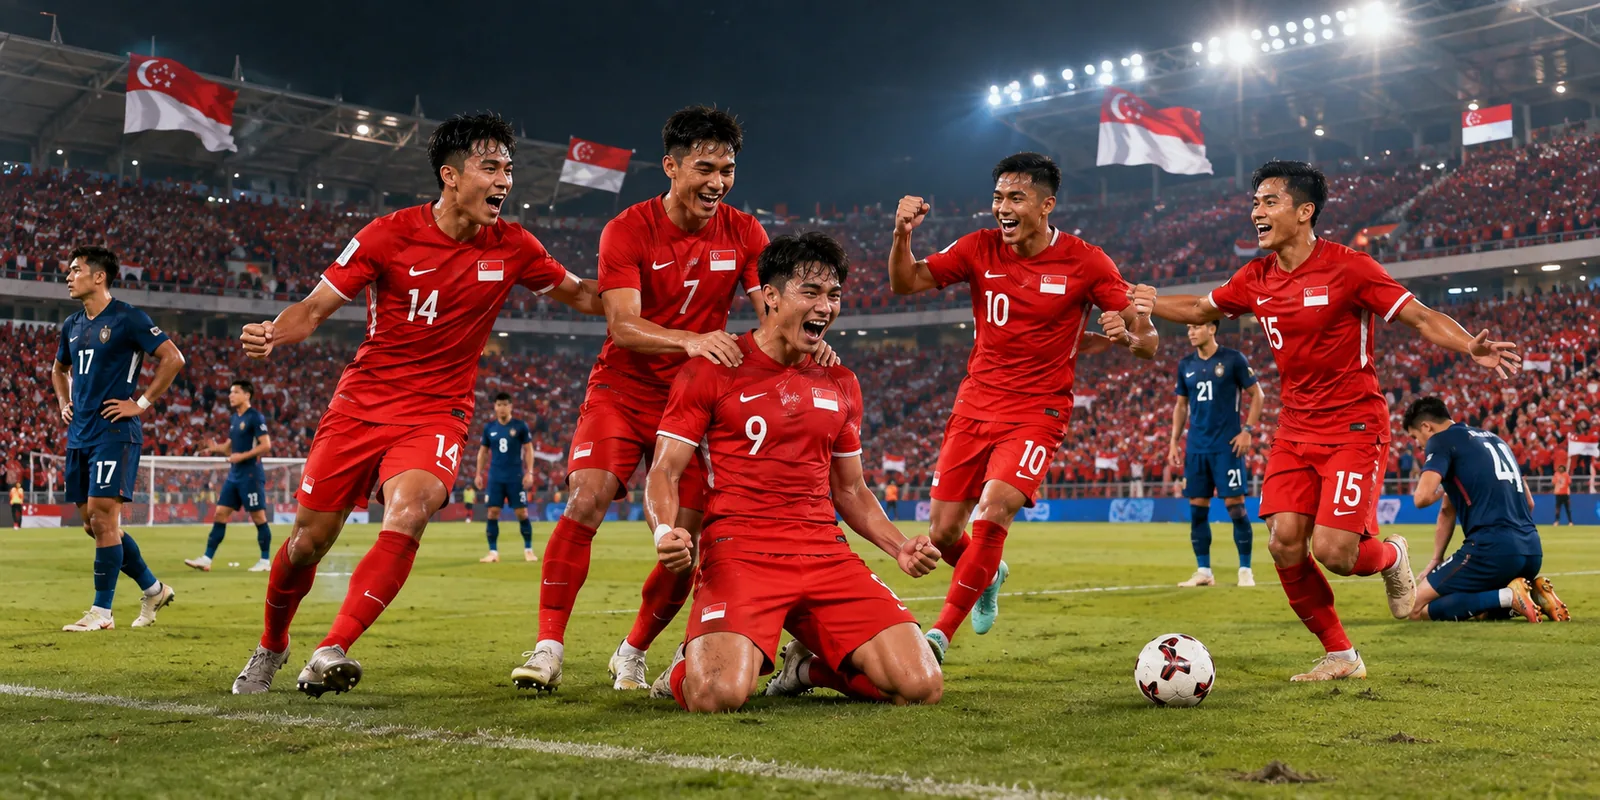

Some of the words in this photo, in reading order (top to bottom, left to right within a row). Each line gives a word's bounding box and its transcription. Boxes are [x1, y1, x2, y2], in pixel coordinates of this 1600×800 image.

[407, 289, 439, 325] 14
[679, 279, 700, 315] 7
[985, 290, 1010, 327] 10
[1260, 316, 1284, 350] 15
[78, 349, 95, 375] 17
[1196, 380, 1213, 402] 21
[435, 434, 459, 471] 14
[499, 437, 508, 453] 8
[745, 415, 768, 456] 9
[96, 461, 117, 484] 17
[1018, 440, 1048, 476] 10
[1227, 469, 1242, 487] 21
[1333, 471, 1364, 507] 15
